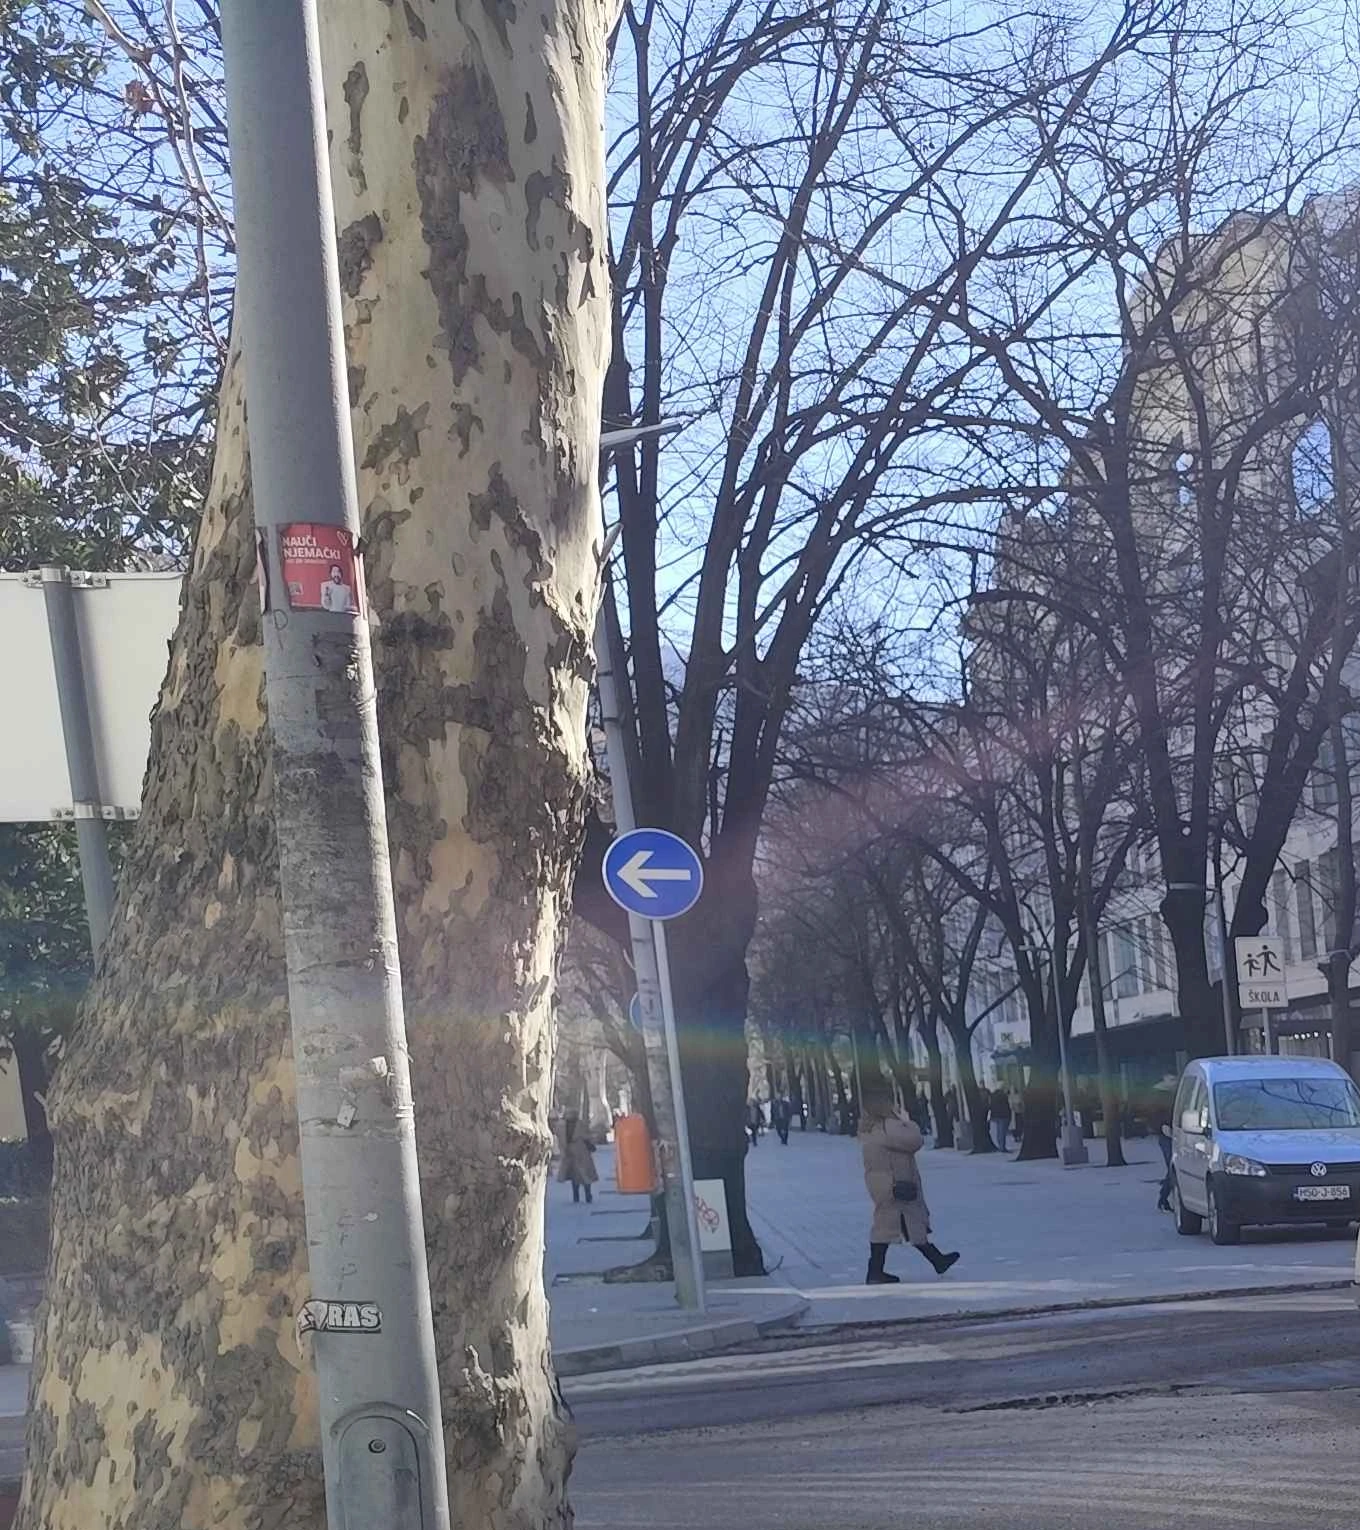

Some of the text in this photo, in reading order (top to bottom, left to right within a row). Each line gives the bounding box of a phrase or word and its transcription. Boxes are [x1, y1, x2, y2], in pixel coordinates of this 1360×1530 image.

[282, 534, 317, 547] NAUČI
[283, 547, 341, 560] NJEMAČKI
[1248, 989, 1281, 1002] ŠKOLA
